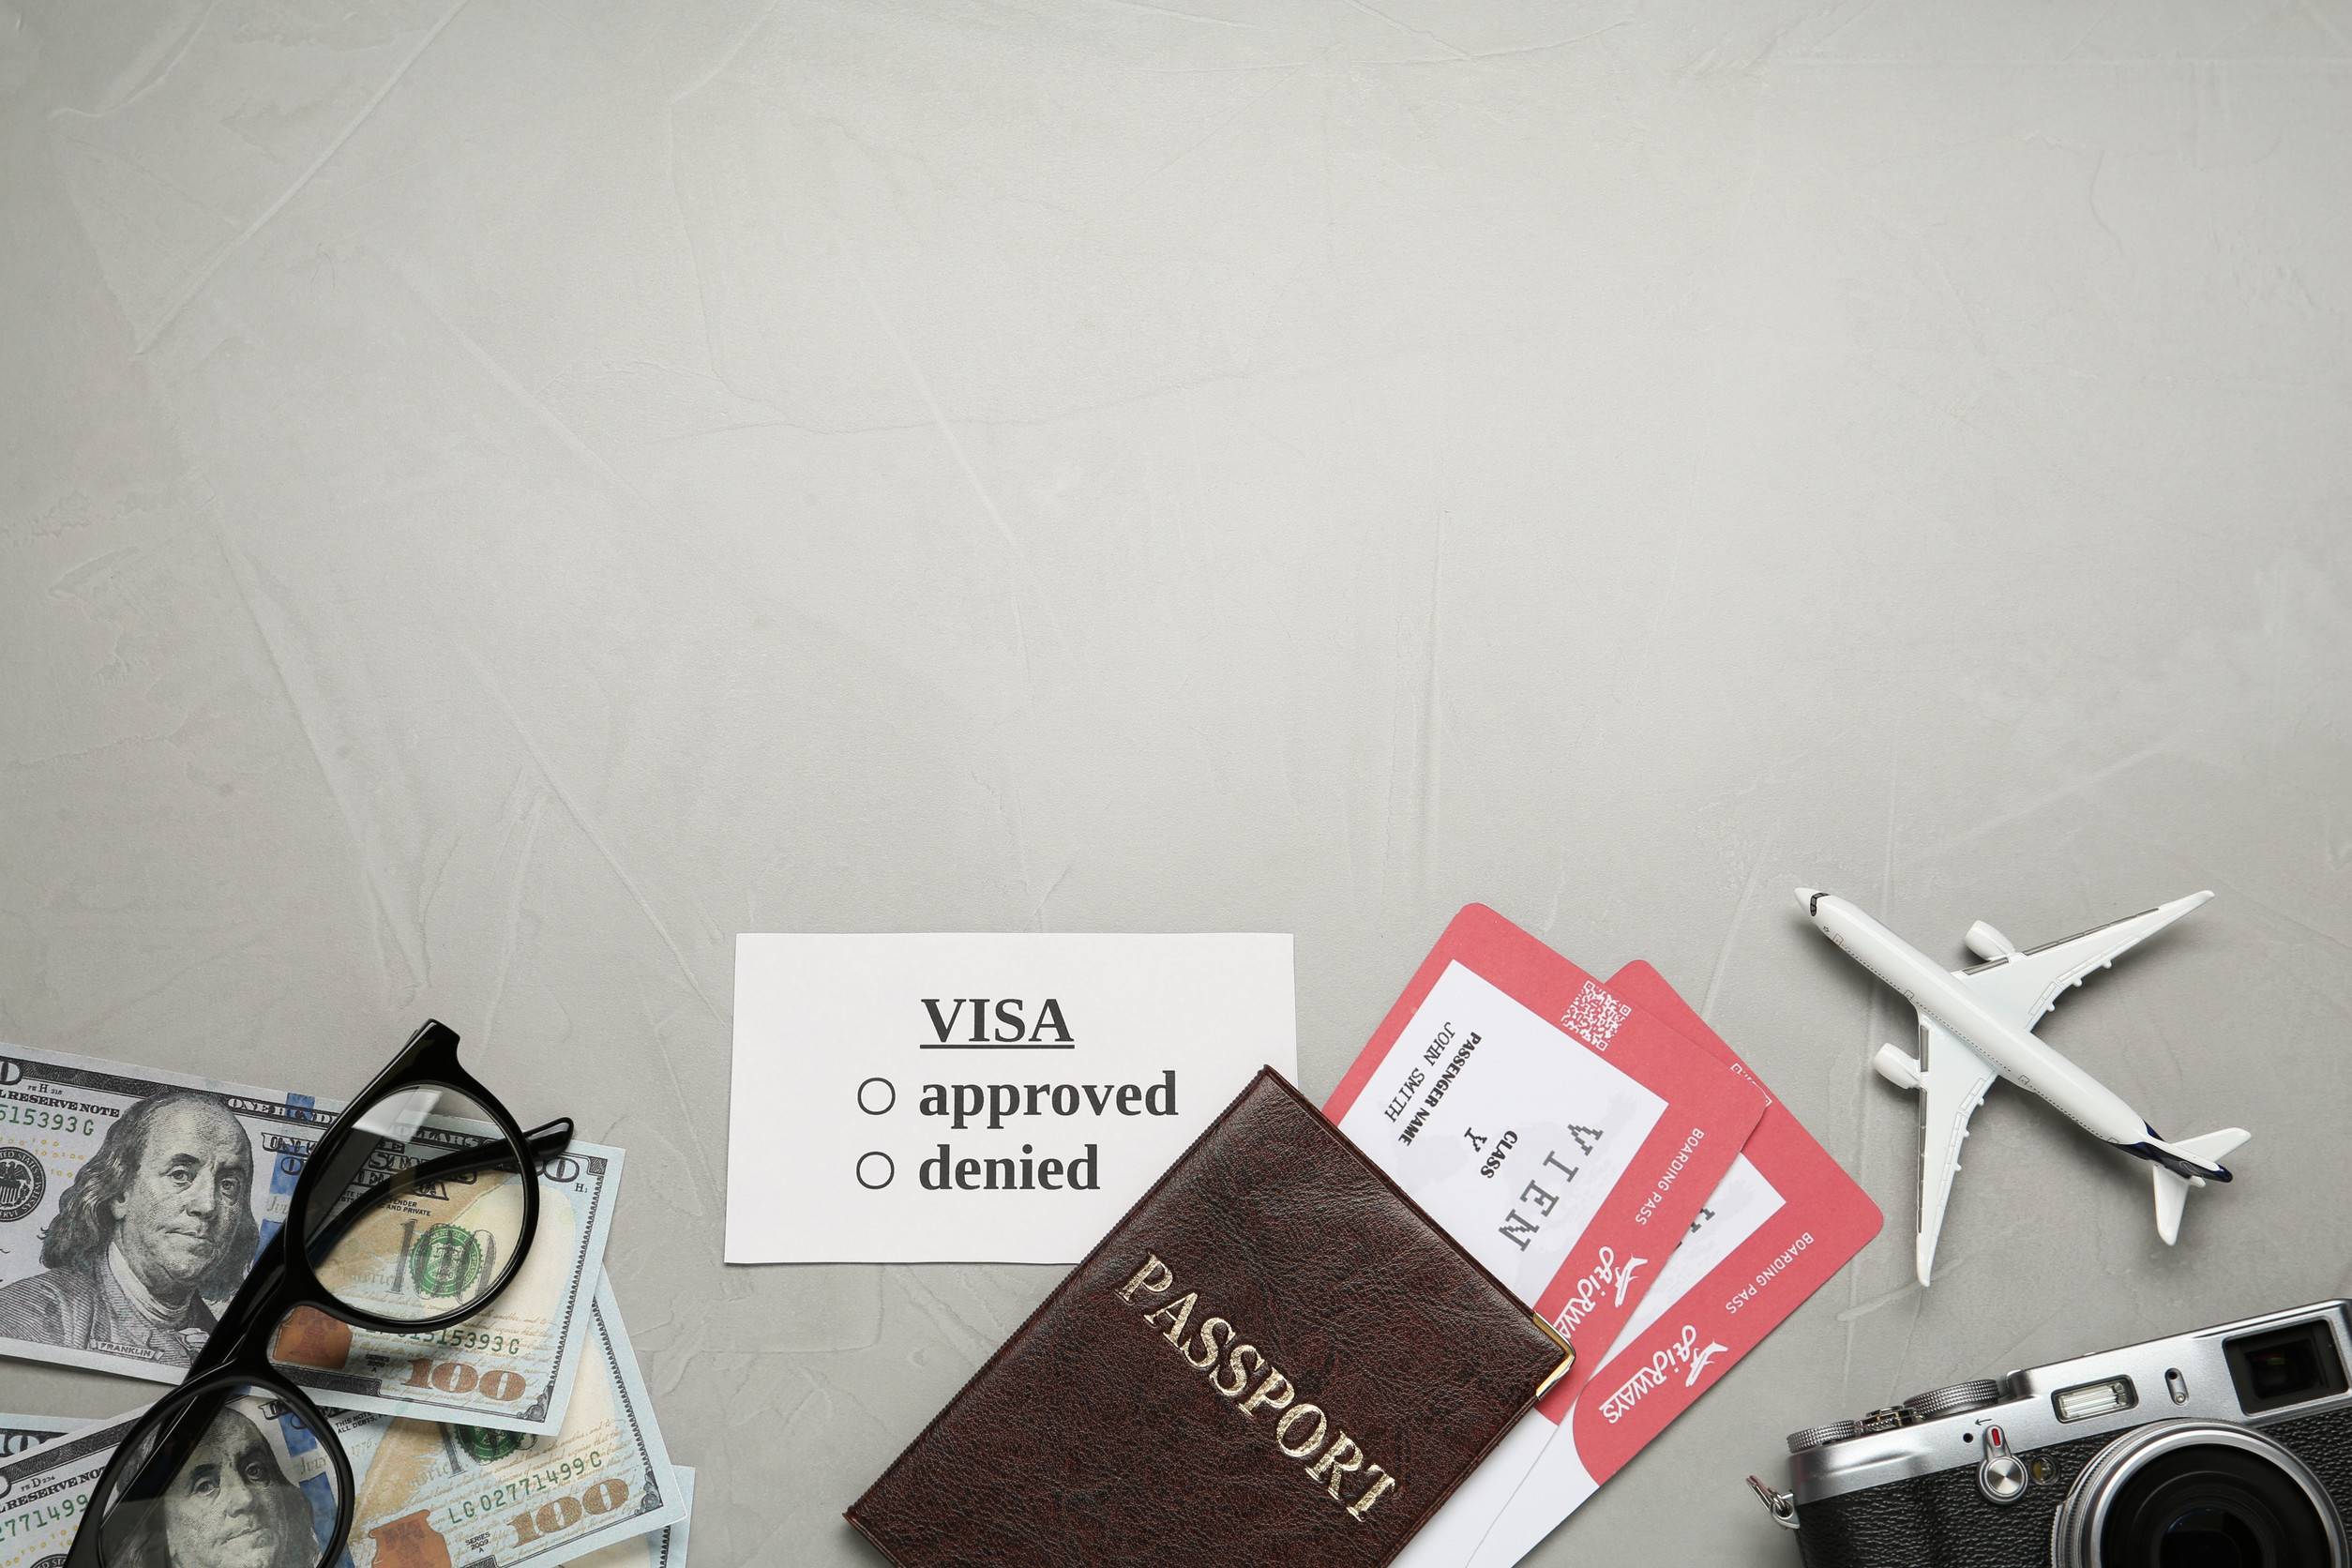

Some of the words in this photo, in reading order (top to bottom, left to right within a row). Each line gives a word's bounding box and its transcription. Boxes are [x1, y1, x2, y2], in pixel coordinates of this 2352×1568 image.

[920, 998, 1076, 1044] VISA
[1424, 1021, 1455, 1067] JOHN
[1425, 1031, 1482, 1108] PASSENGER
[8, 1090, 79, 1111] RESERVE
[79, 1102, 120, 1118] NOTE
[227, 1097, 271, 1114] ONE
[919, 1070, 1179, 1129] approved
[1384, 1068, 1425, 1123] SMITH
[83, 1119, 94, 1136] G
[1397, 1108, 1430, 1146] NAME
[1464, 1127, 1487, 1152] Y
[919, 1143, 1100, 1190] denied
[1480, 1130, 1518, 1178] CLASS
[1657, 1127, 1705, 1192] BOARDING
[403, 1206, 431, 1216] PRIVATE
[1635, 1190, 1663, 1226] PASS
[1756, 1232, 1815, 1288] BOARDING
[1726, 1286, 1758, 1315] PASS
[100, 1342, 151, 1357] FRANKLIN
[508, 1337, 520, 1355] G
[400, 1357, 527, 1402] 100
[1114, 1250, 1395, 1522] PASSPORT
[336, 1417, 353, 1428] THIS
[338, 1425, 352, 1434] ALL
[8, 1479, 78, 1510] RESERVE
[77, 1465, 106, 1485] NOT
[32, 1478, 41, 1488] D
[448, 1500, 475, 1525] LG
[480, 1457, 585, 1512] 02771499
[589, 1451, 603, 1469] C
[506, 1478, 630, 1548] 100
[465, 1531, 490, 1545] SERIES
